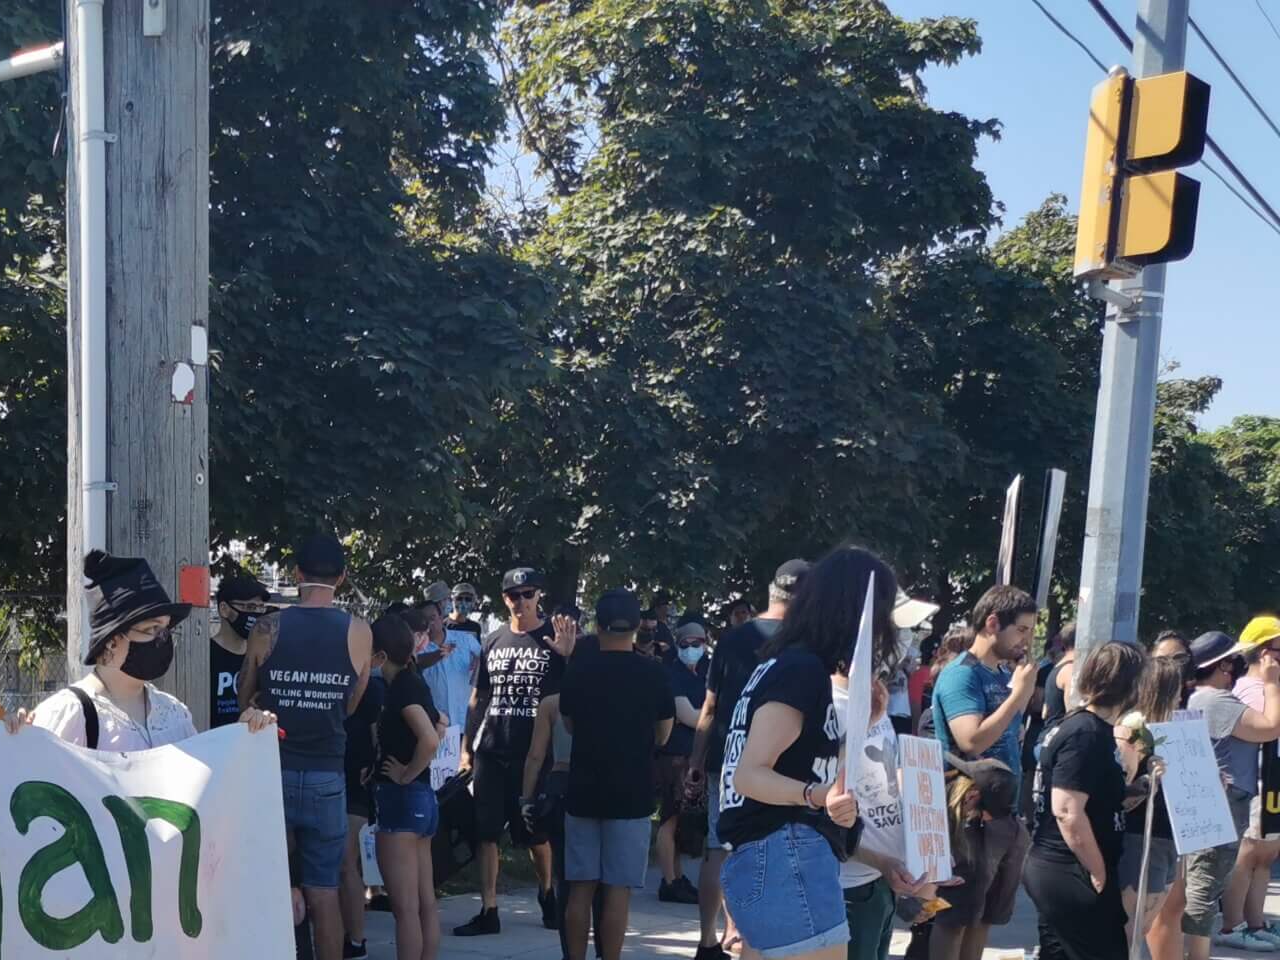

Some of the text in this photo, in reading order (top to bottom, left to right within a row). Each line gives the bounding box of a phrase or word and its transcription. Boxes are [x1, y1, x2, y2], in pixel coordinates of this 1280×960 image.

[488, 648, 551, 661] ANIMALS
[269, 669, 351, 686] VEGAN MUSCLE
[278, 699, 295, 707] NOT
